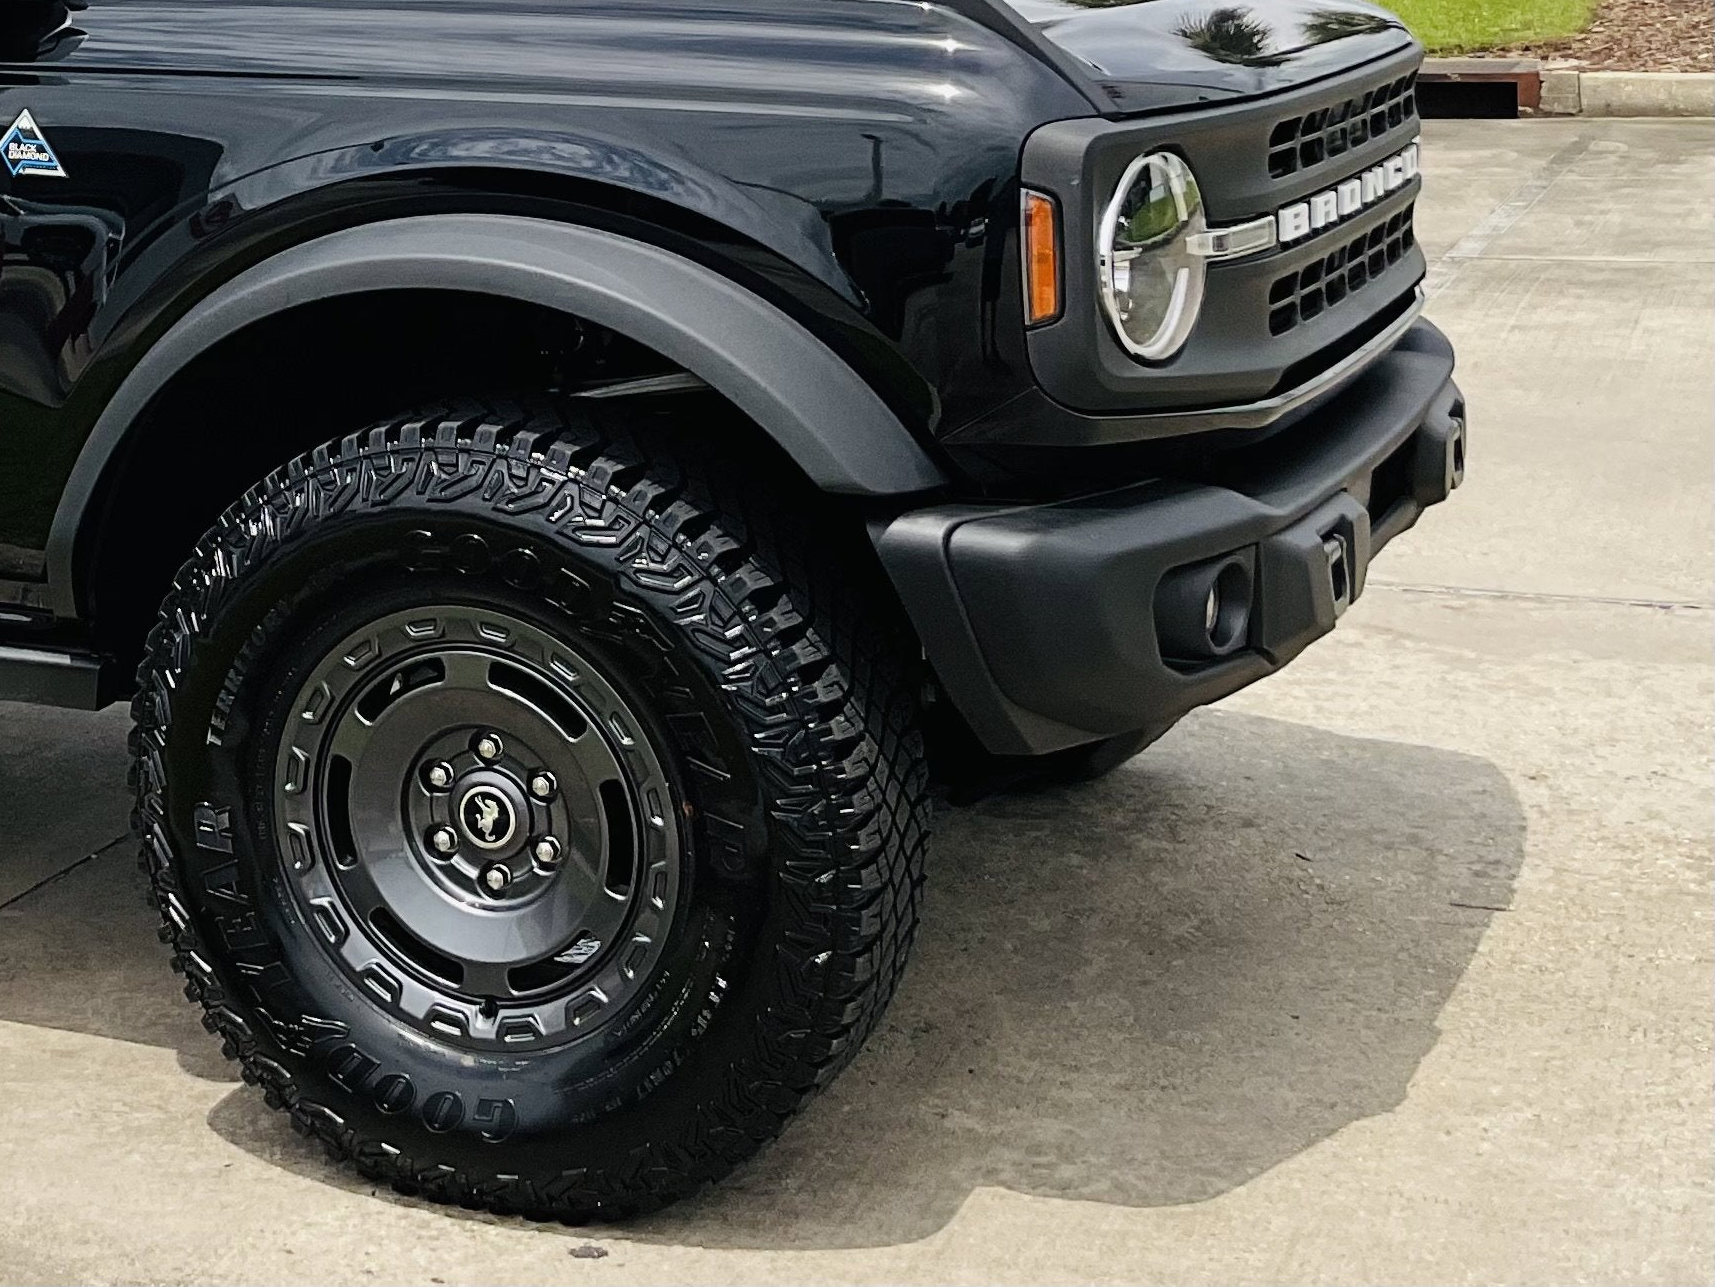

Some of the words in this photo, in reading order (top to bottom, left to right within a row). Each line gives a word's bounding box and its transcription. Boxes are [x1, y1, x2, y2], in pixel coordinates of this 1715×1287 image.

[8, 142, 37, 152] BLACK
[8, 150, 50, 162] DIAMOND
[1277, 143, 1419, 243] BRONCO
